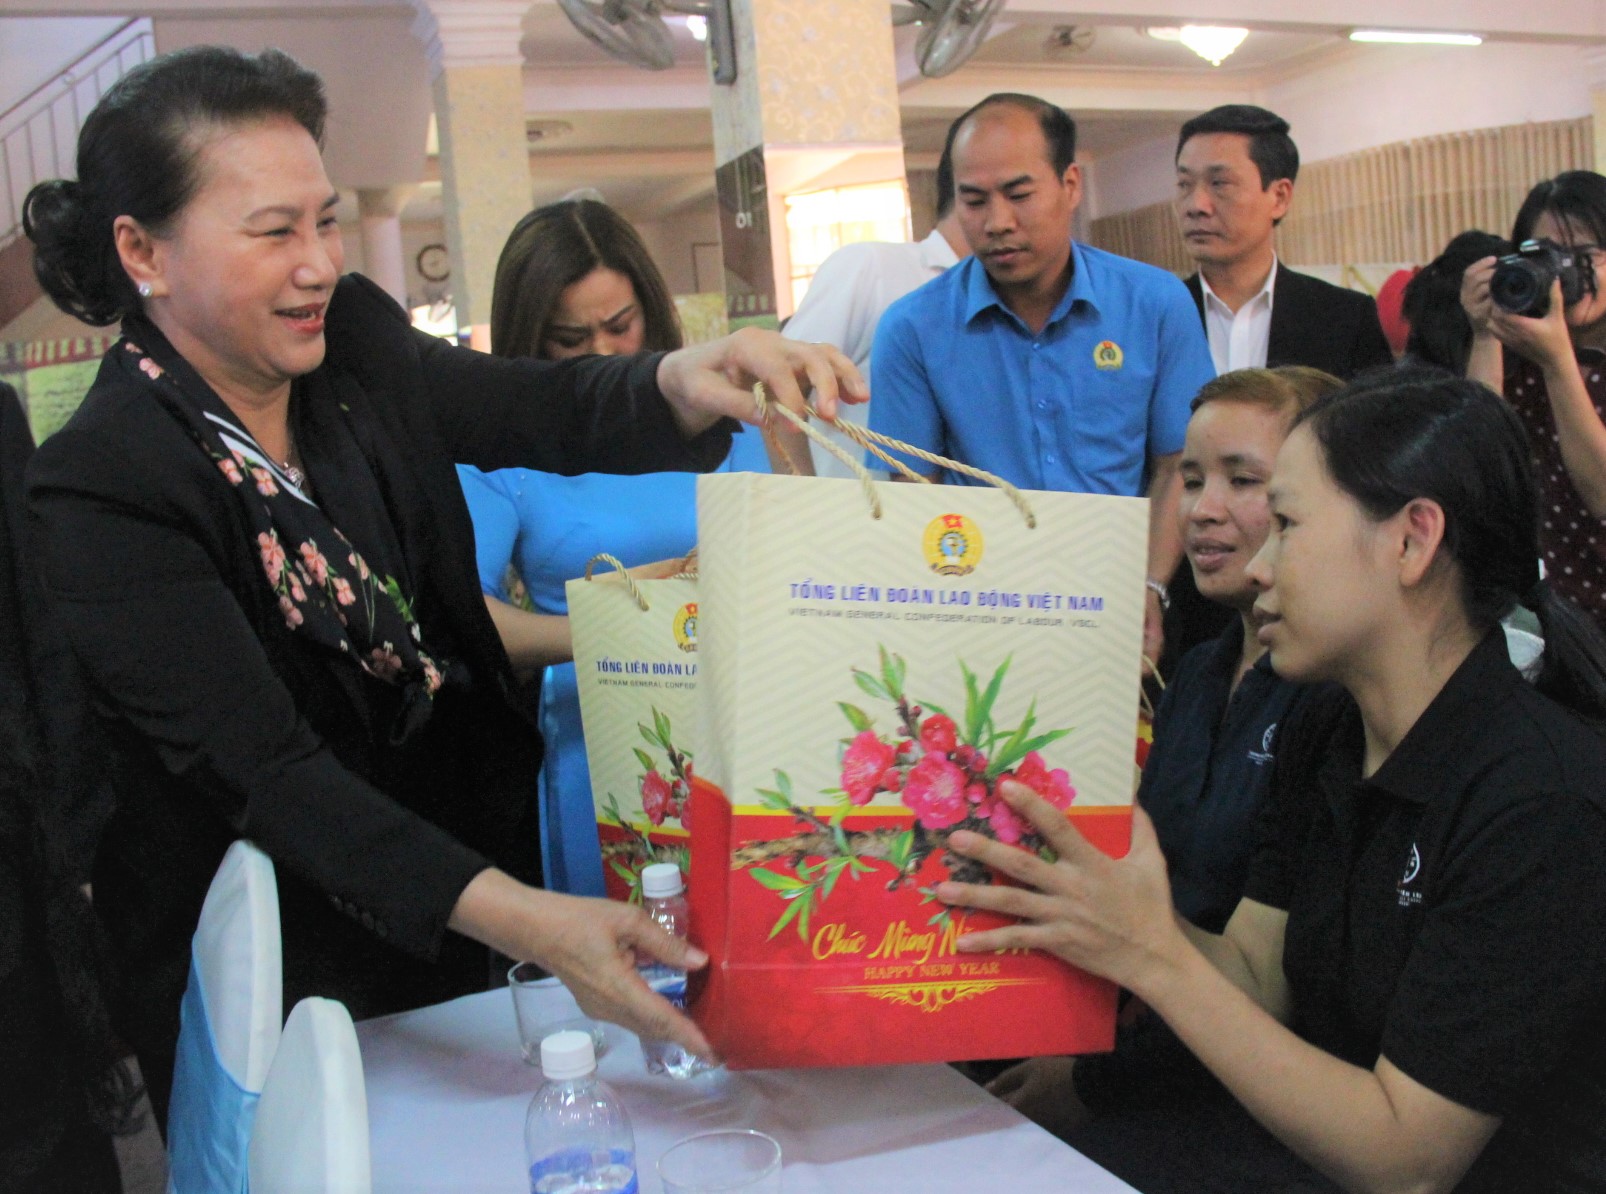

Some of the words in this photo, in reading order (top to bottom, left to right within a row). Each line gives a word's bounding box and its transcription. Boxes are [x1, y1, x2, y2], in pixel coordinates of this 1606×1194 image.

[841, 583, 880, 602] LIÊN
[887, 585, 934, 604] ĐOÀN
[939, 590, 971, 605] LAO
[976, 589, 1021, 610] ĐỘNG
[1027, 591, 1062, 612] VIỆT
[1067, 595, 1104, 611] NAM
[788, 607, 843, 618] VIETNAM
[846, 609, 901, 621] GENERAL
[904, 611, 996, 623] CONFEDERATION
[1000, 616, 1015, 625] OF
[1018, 616, 1063, 627] LABOUR
[625, 660, 649, 674] LIÊN
[652, 661, 682, 675] ĐOÀN
[685, 663, 697, 676] LA
[598, 678, 628, 687] VIETNAM
[630, 679, 662, 689] GENERAL
[811, 922, 867, 961] Chúc
[863, 966, 915, 980] HAPPY
[919, 963, 954, 978] NEW
[959, 961, 1000, 976] YEAR
